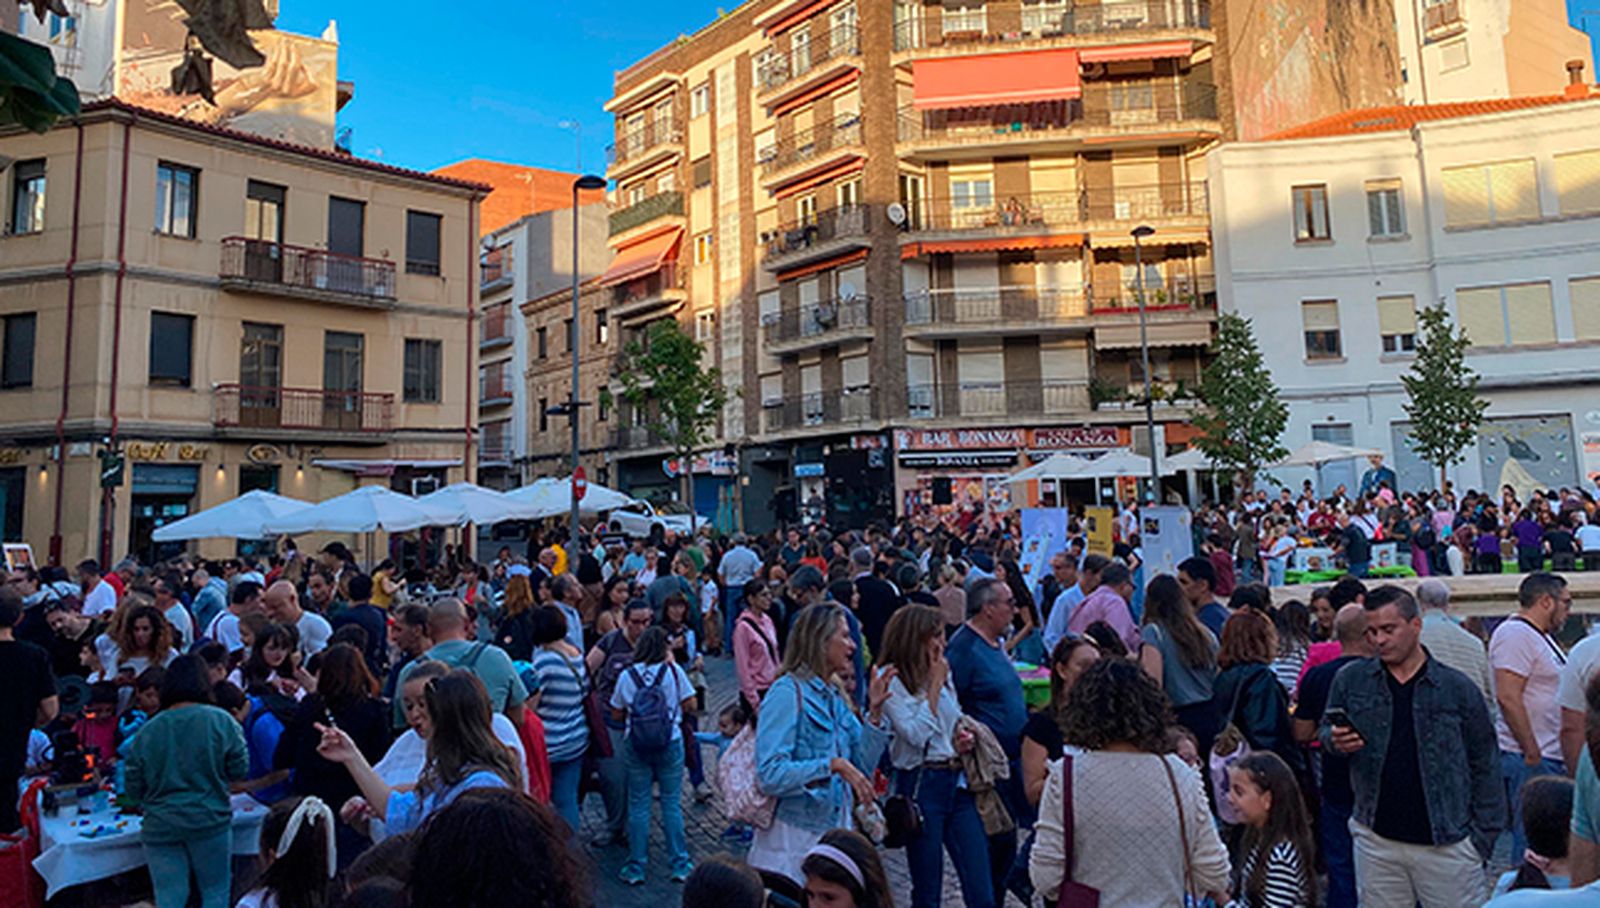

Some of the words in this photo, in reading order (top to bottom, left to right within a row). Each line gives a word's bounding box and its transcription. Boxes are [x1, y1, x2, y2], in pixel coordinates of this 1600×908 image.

[922, 431, 953, 447] BAR
[959, 429, 1020, 445] BONANZA
[1036, 435, 1119, 448] BONANZA
